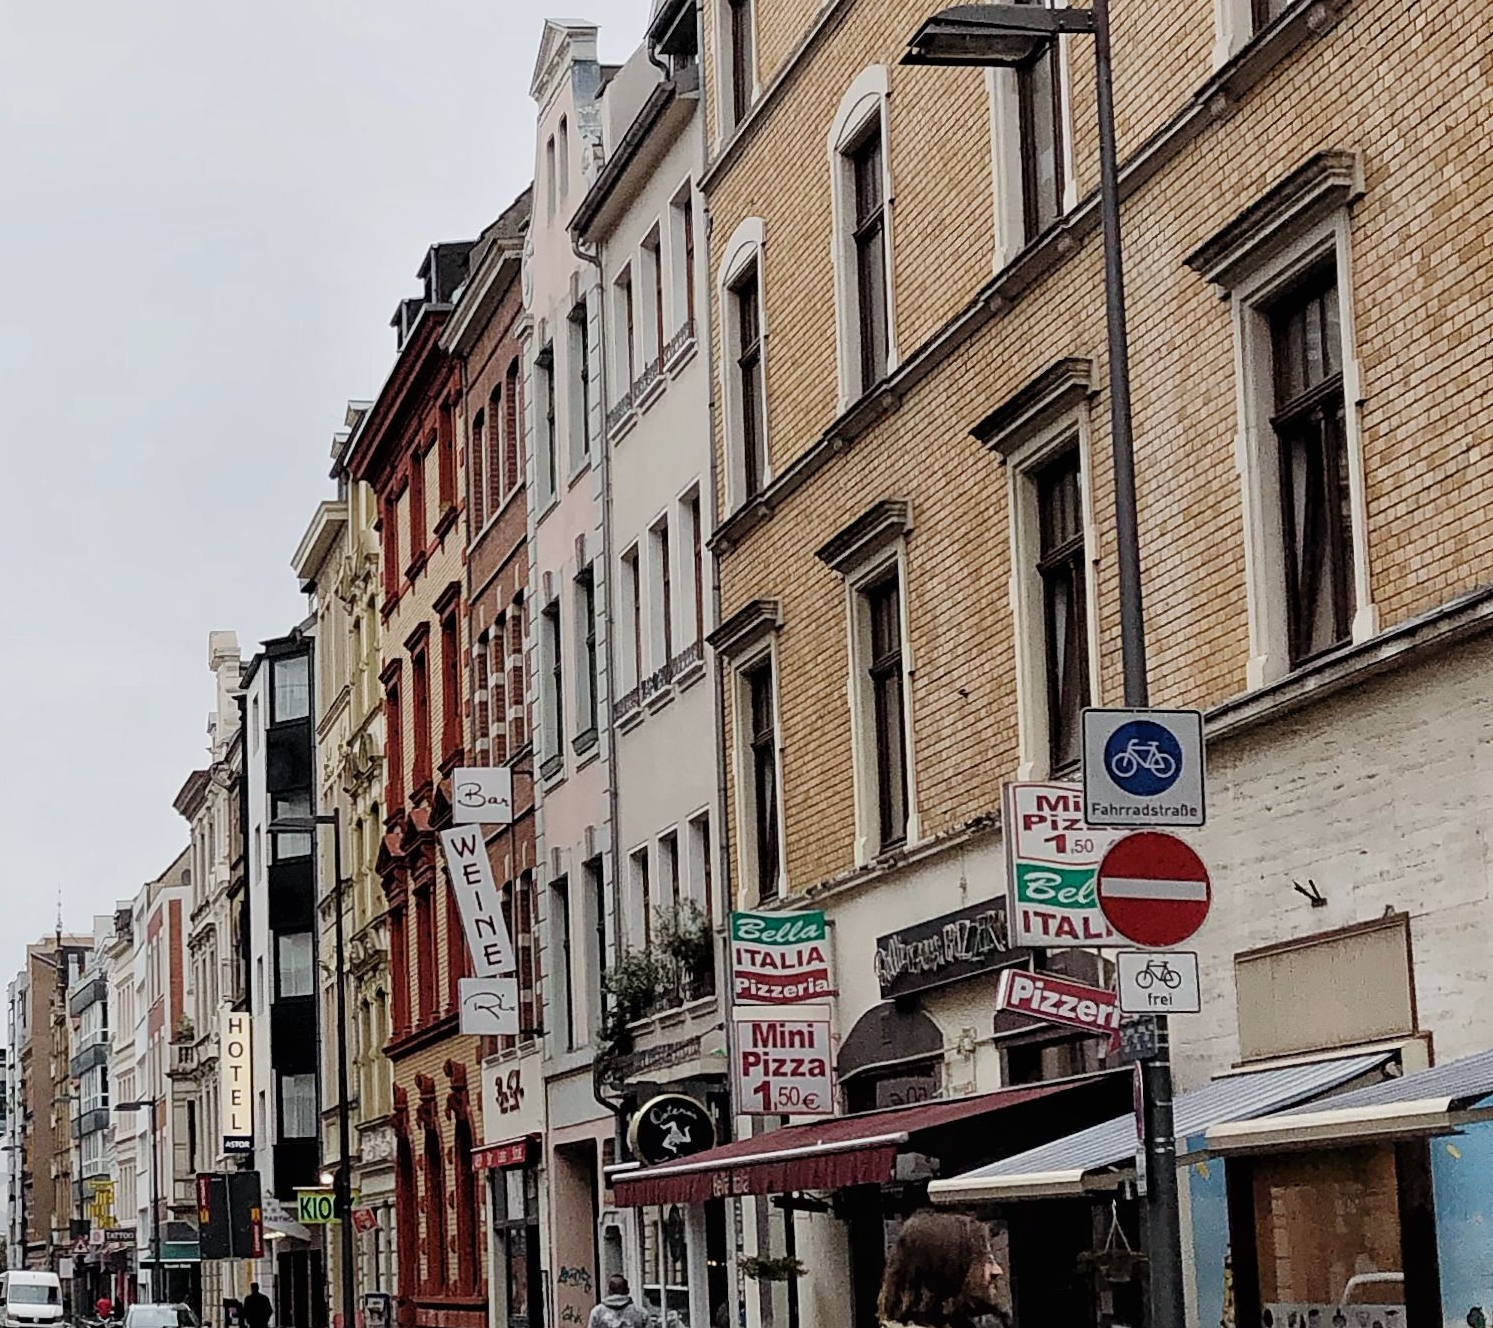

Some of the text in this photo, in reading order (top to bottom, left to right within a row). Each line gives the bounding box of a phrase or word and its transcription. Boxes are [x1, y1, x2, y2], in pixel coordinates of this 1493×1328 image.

[458, 782, 510, 808] Bar
[1036, 795, 1082, 813] Mi
[1092, 803, 1198, 817] Fahrradstraße
[1023, 815, 1132, 831] Piz
[450, 834, 503, 966] WEINE
[1024, 871, 1098, 904] Bel
[735, 918, 822, 943] Bella
[1023, 910, 1114, 940] ITAL
[736, 946, 826, 970] ITALIA
[735, 977, 830, 998] Pizzeria
[1147, 992, 1174, 1006] frei
[1010, 978, 1122, 1028] Pizzeri
[751, 1023, 815, 1048] Mini
[228, 1017, 244, 1131] HOTEL
[741, 1051, 827, 1077] Pizza
[224, 1140, 251, 1149] ASTOR
[300, 1196, 354, 1221] KIO
[106, 1231, 134, 1240] TATTOO
